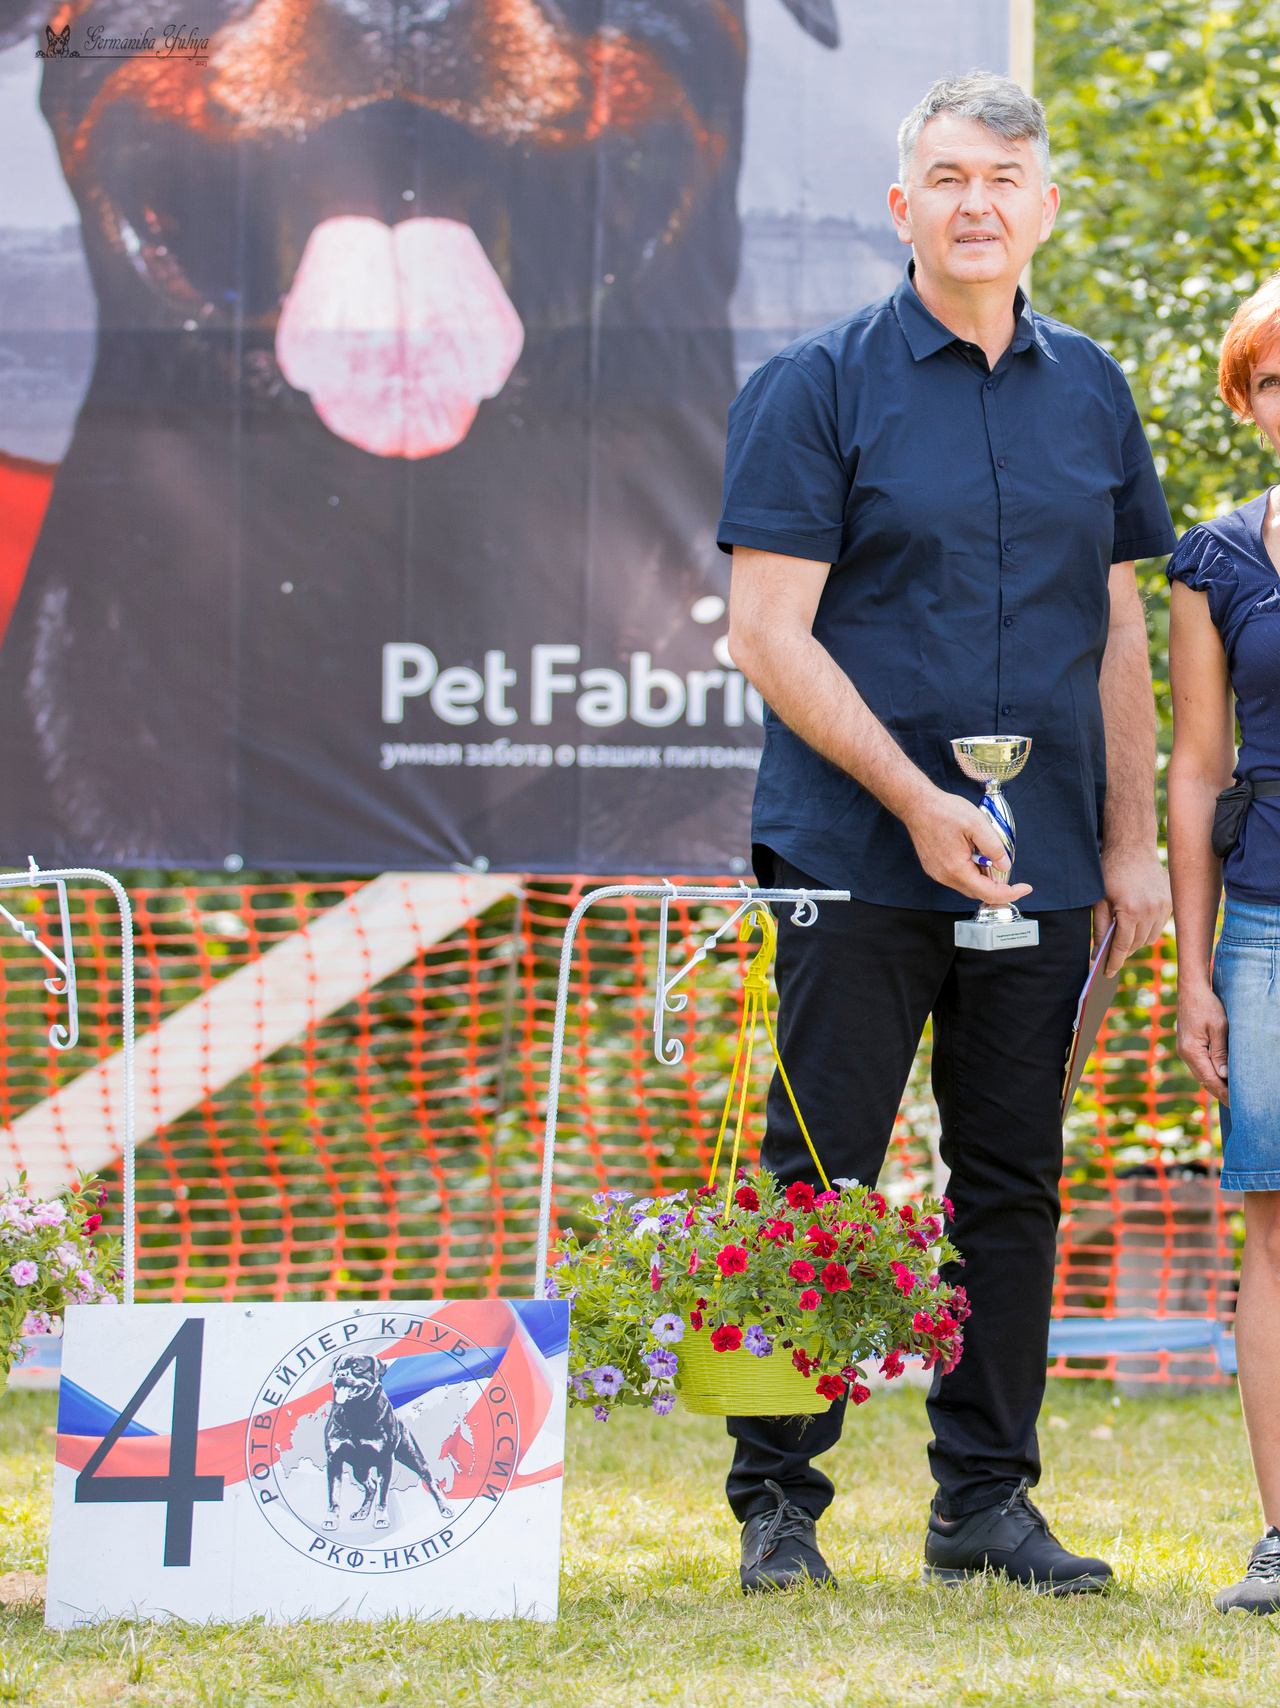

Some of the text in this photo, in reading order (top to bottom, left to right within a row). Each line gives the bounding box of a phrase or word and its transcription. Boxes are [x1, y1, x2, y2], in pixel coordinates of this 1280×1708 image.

[381, 642, 518, 725] Pet
[380, 742, 462, 770] умная
[463, 737, 553, 767] забота
[554, 744, 576, 768] о
[576, 745, 662, 768] ваших
[74, 1317, 225, 1567] 4
[250, 1317, 515, 1506] РОТВЕЙЛЕР КЛУБ РОССИИ
[308, 1528, 455, 1569] РКФ-НКПР
